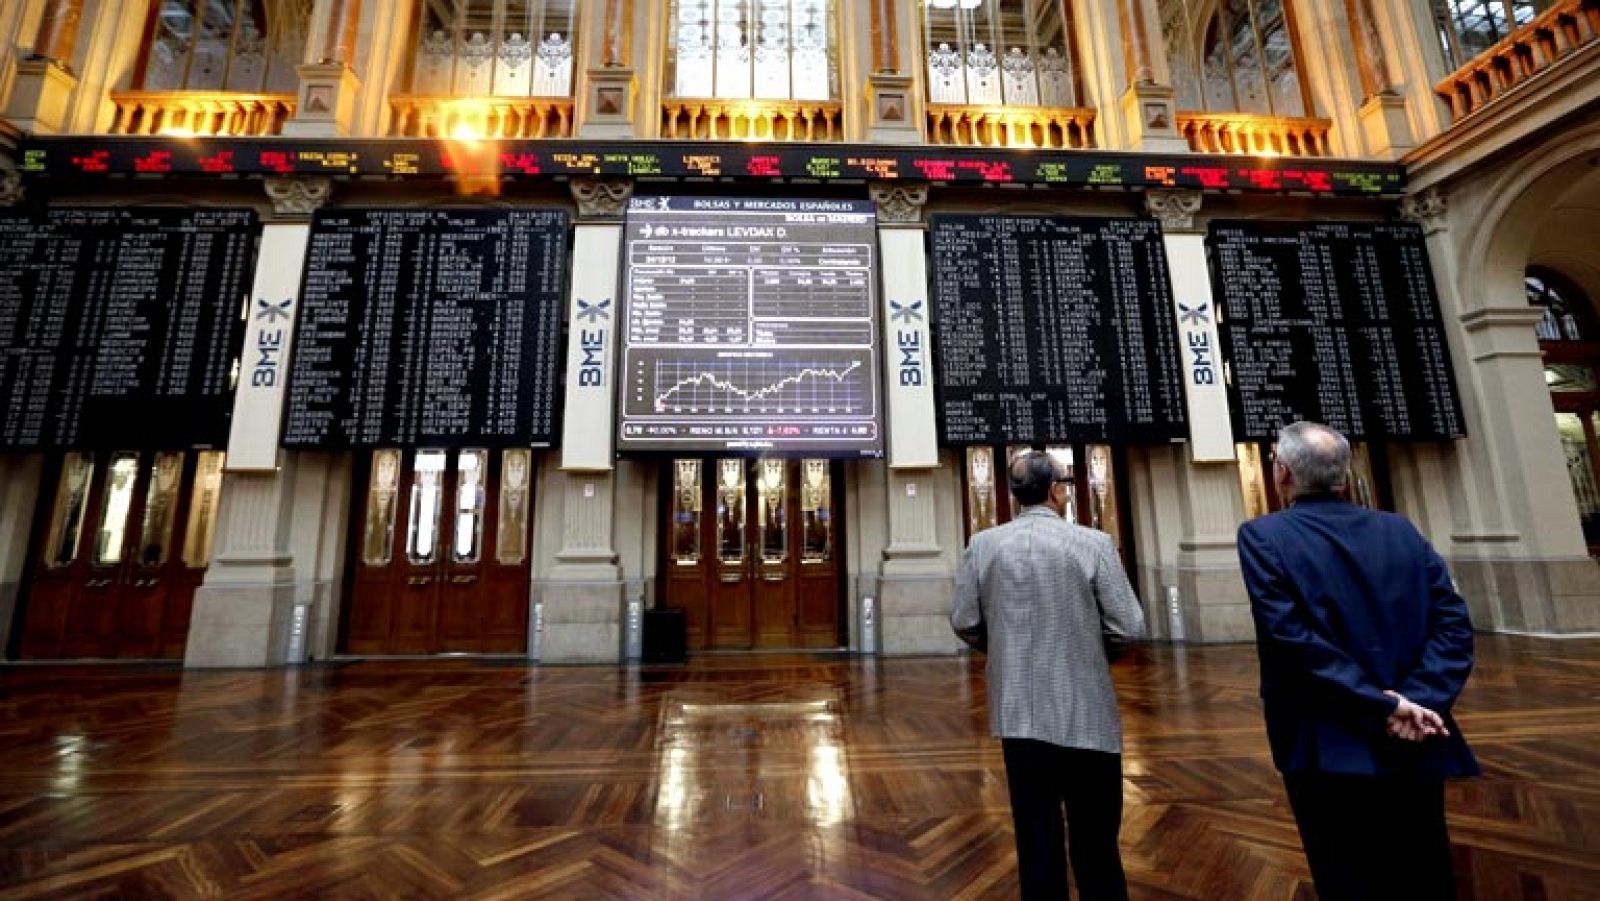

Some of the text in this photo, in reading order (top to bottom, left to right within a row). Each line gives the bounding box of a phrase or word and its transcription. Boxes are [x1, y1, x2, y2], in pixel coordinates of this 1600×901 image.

[694, 200, 853, 211] BOLSAS Y MERCADOS ESPAÑOLES
[727, 227, 774, 238] LEVDAX
[252, 329, 281, 386] BME
[579, 329, 602, 386] BME
[898, 330, 921, 386] BME
[1187, 331, 1213, 385] BME
